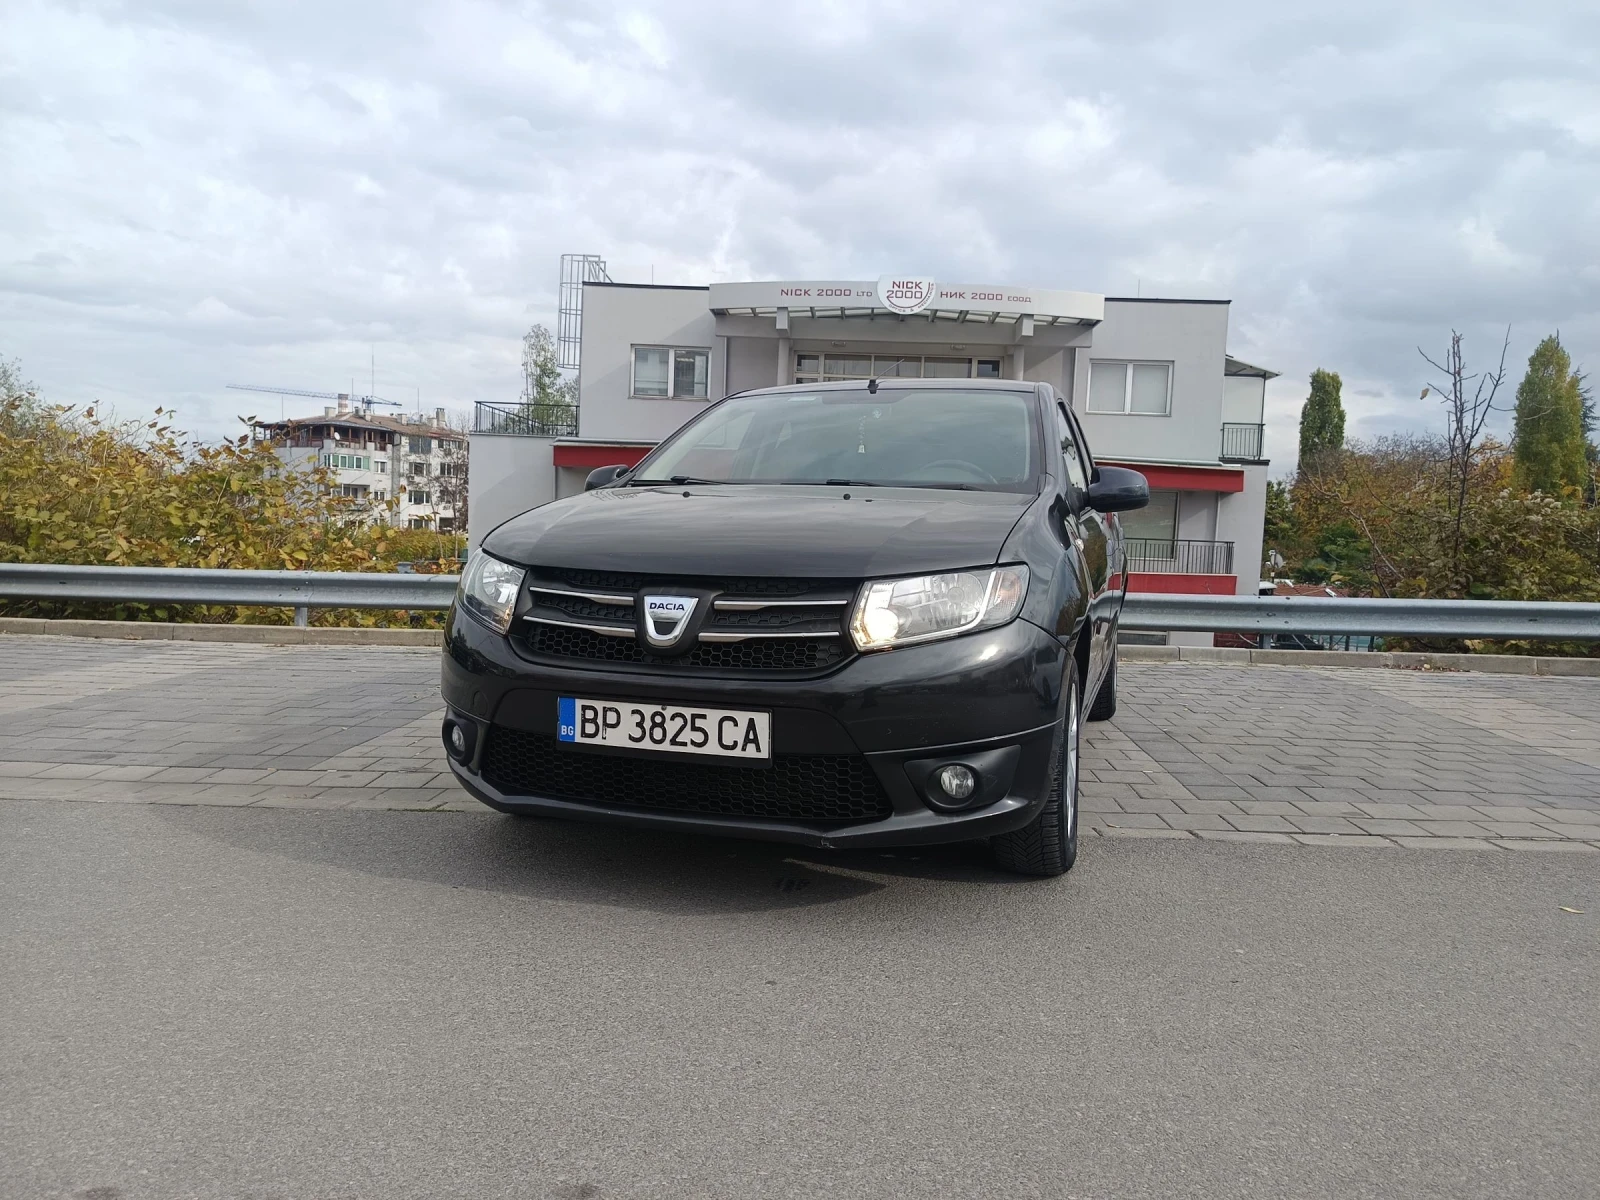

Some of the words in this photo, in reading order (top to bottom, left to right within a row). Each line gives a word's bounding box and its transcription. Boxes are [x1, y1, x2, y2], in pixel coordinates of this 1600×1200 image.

[892, 280, 923, 290] NICK
[780, 288, 812, 297] NICK
[816, 288, 852, 297] 2000
[886, 290, 923, 299] 2000
[940, 291, 966, 299] НИК
[971, 292, 1003, 301] 2000
[649, 602, 685, 611] DACIA
[561, 725, 574, 736] BG
[628, 708, 710, 749] 3825
[717, 715, 762, 753] CA
